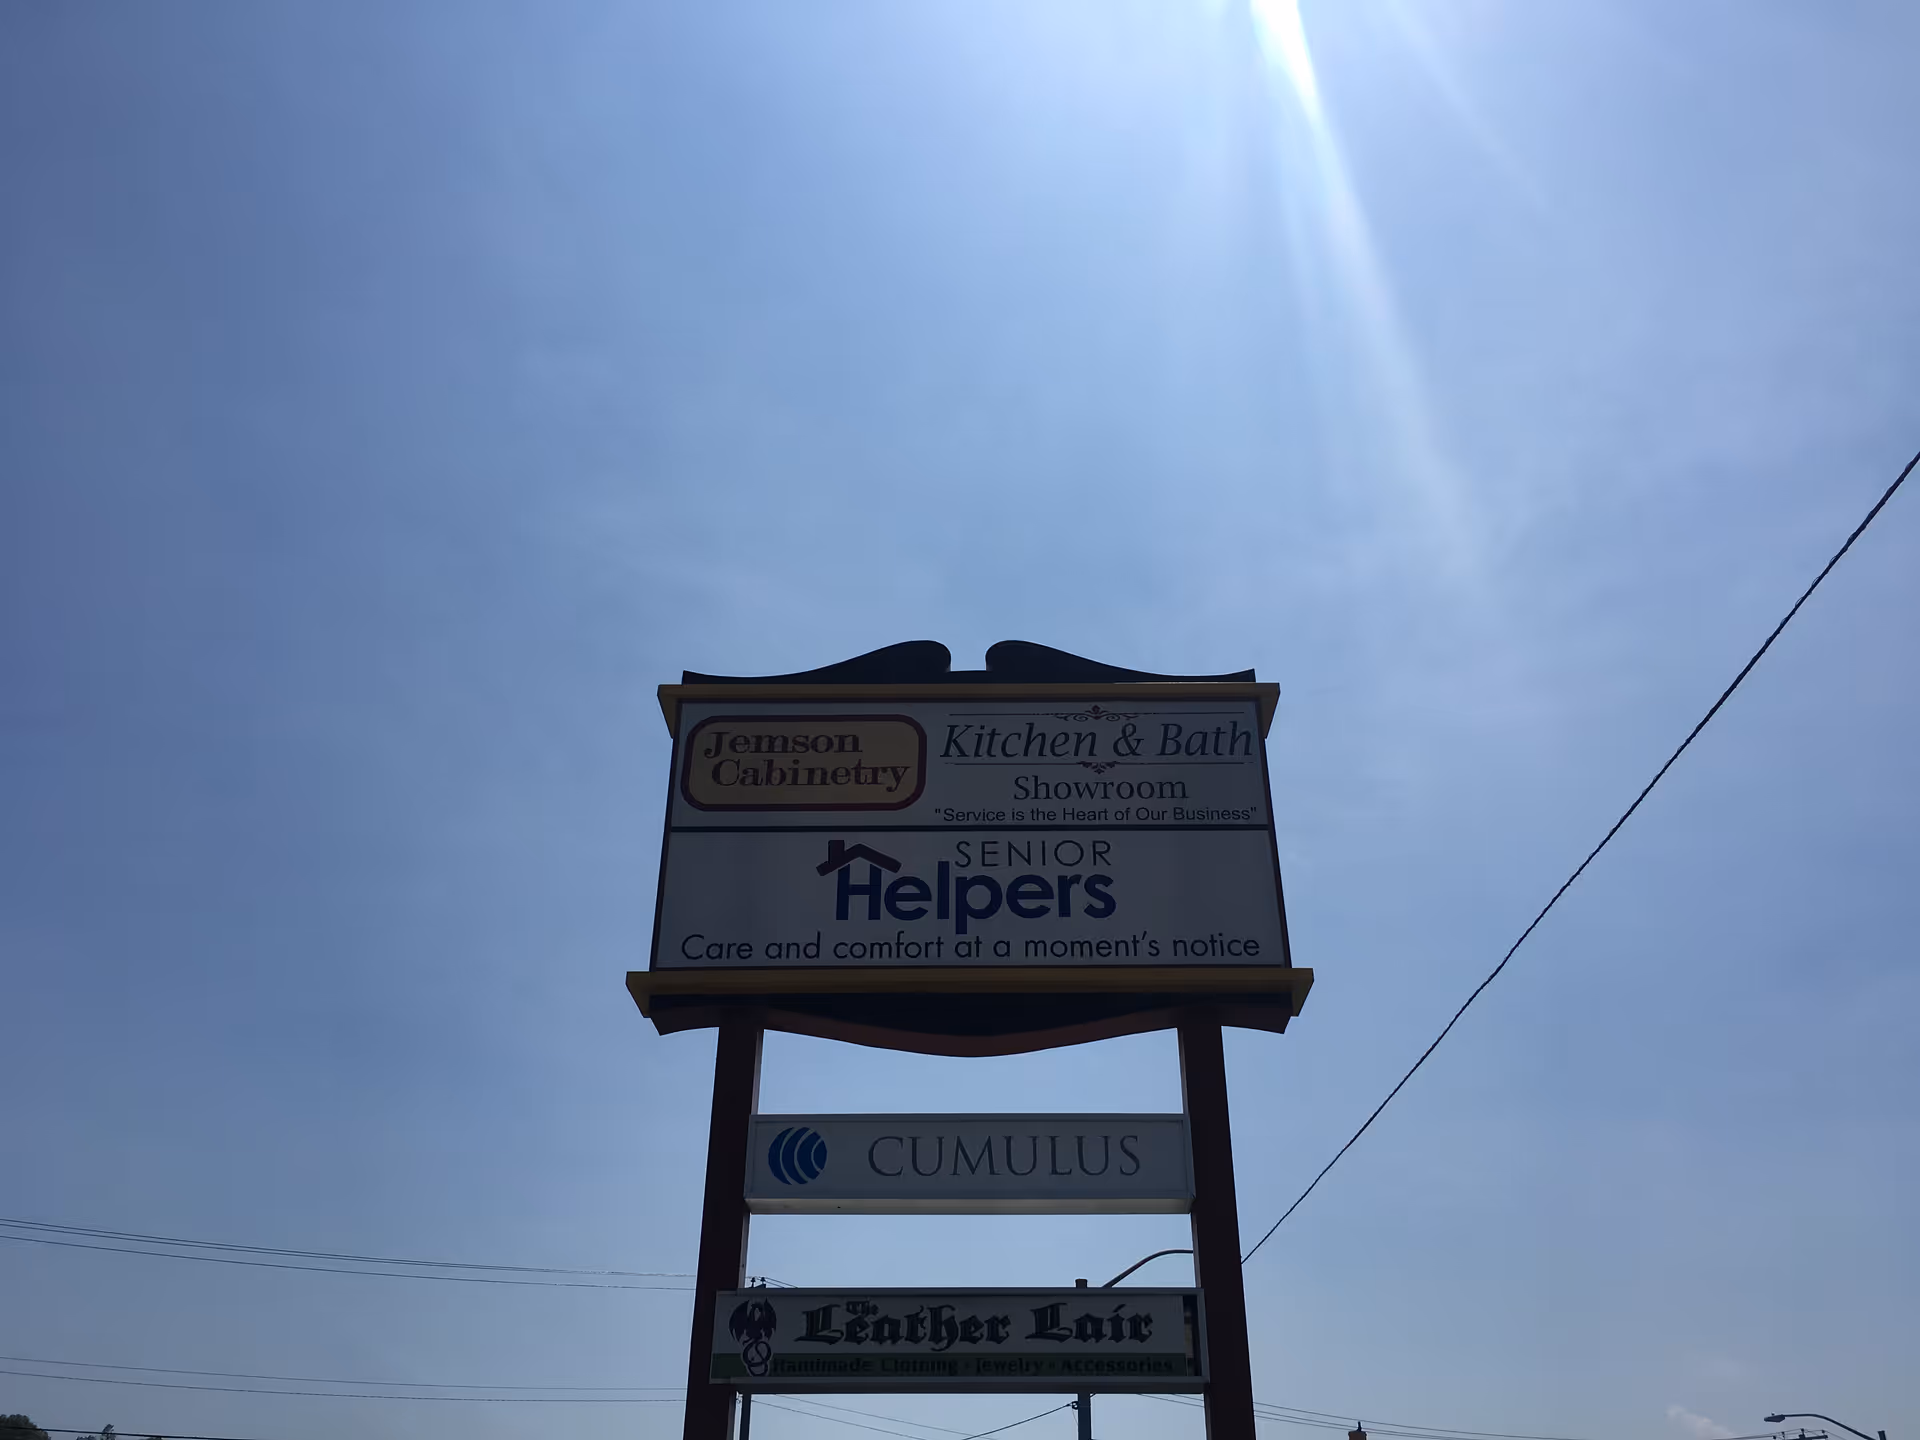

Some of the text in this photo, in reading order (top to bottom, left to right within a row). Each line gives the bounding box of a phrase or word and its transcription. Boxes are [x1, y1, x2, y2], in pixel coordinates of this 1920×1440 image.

[704, 731, 863, 759] Jemson
[940, 720, 1253, 758] Kitchen & Bath
[711, 758, 911, 792] Cabinetry
[1013, 775, 1189, 800] Showroom
[934, 806, 1257, 821] "Service is the Heart of Our Business"
[954, 840, 1112, 868] SENIOR
[835, 860, 1117, 934] Helpers
[681, 930, 1261, 960] Care and comfort at a moment's notice
[867, 1134, 1141, 1177] CUMULUS
[846, 1300, 880, 1315] The
[794, 1302, 1154, 1352] Leather Lair
[975, 1357, 1044, 1375] Jewelry
[1061, 1356, 1174, 1374] Accessories
